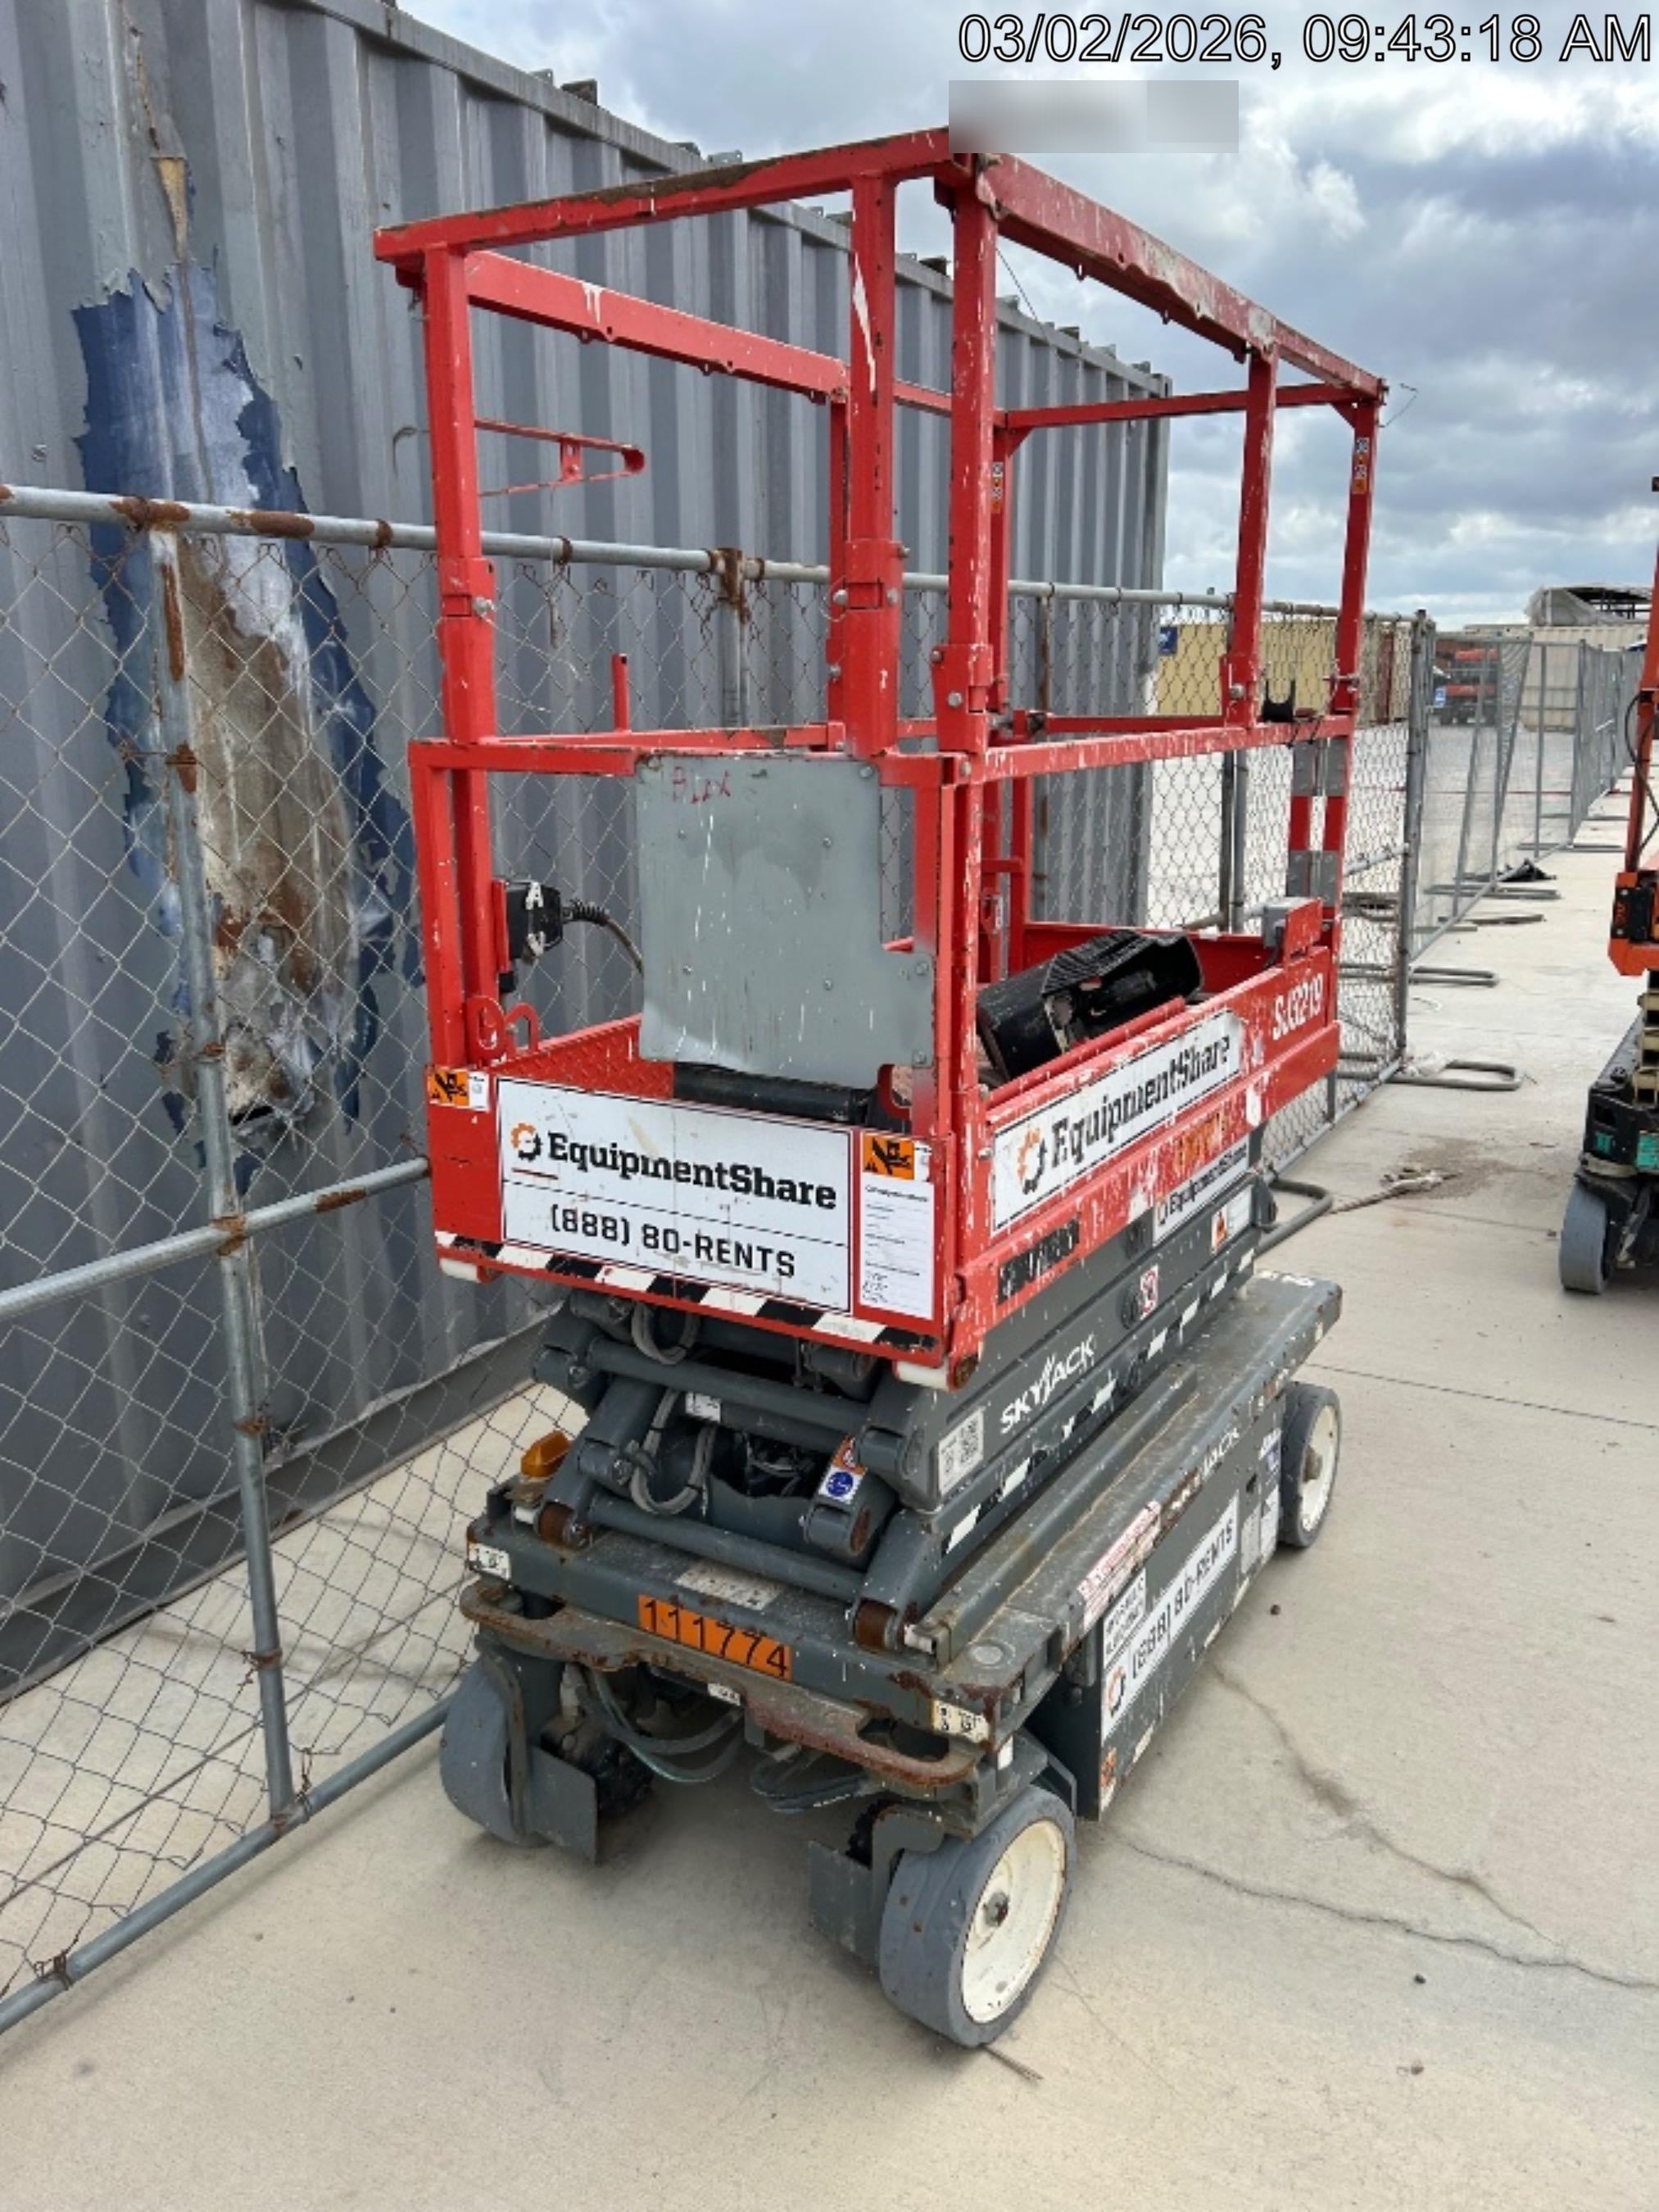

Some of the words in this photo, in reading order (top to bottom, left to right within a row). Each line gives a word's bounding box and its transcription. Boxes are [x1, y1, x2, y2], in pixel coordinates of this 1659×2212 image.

[1051, 1036, 1231, 1168] EquipmentShare
[547, 1131, 836, 1210] EquipmentShare
[551, 1203, 630, 1246] (888)
[642, 1224, 796, 1278] 80-RENTS
[1001, 1331, 1096, 1434] SKYJACK
[645, 1599, 787, 1677] 111774
[1131, 1602, 1172, 1679] (888)
[1174, 1517, 1233, 1616] 80-RENTS
